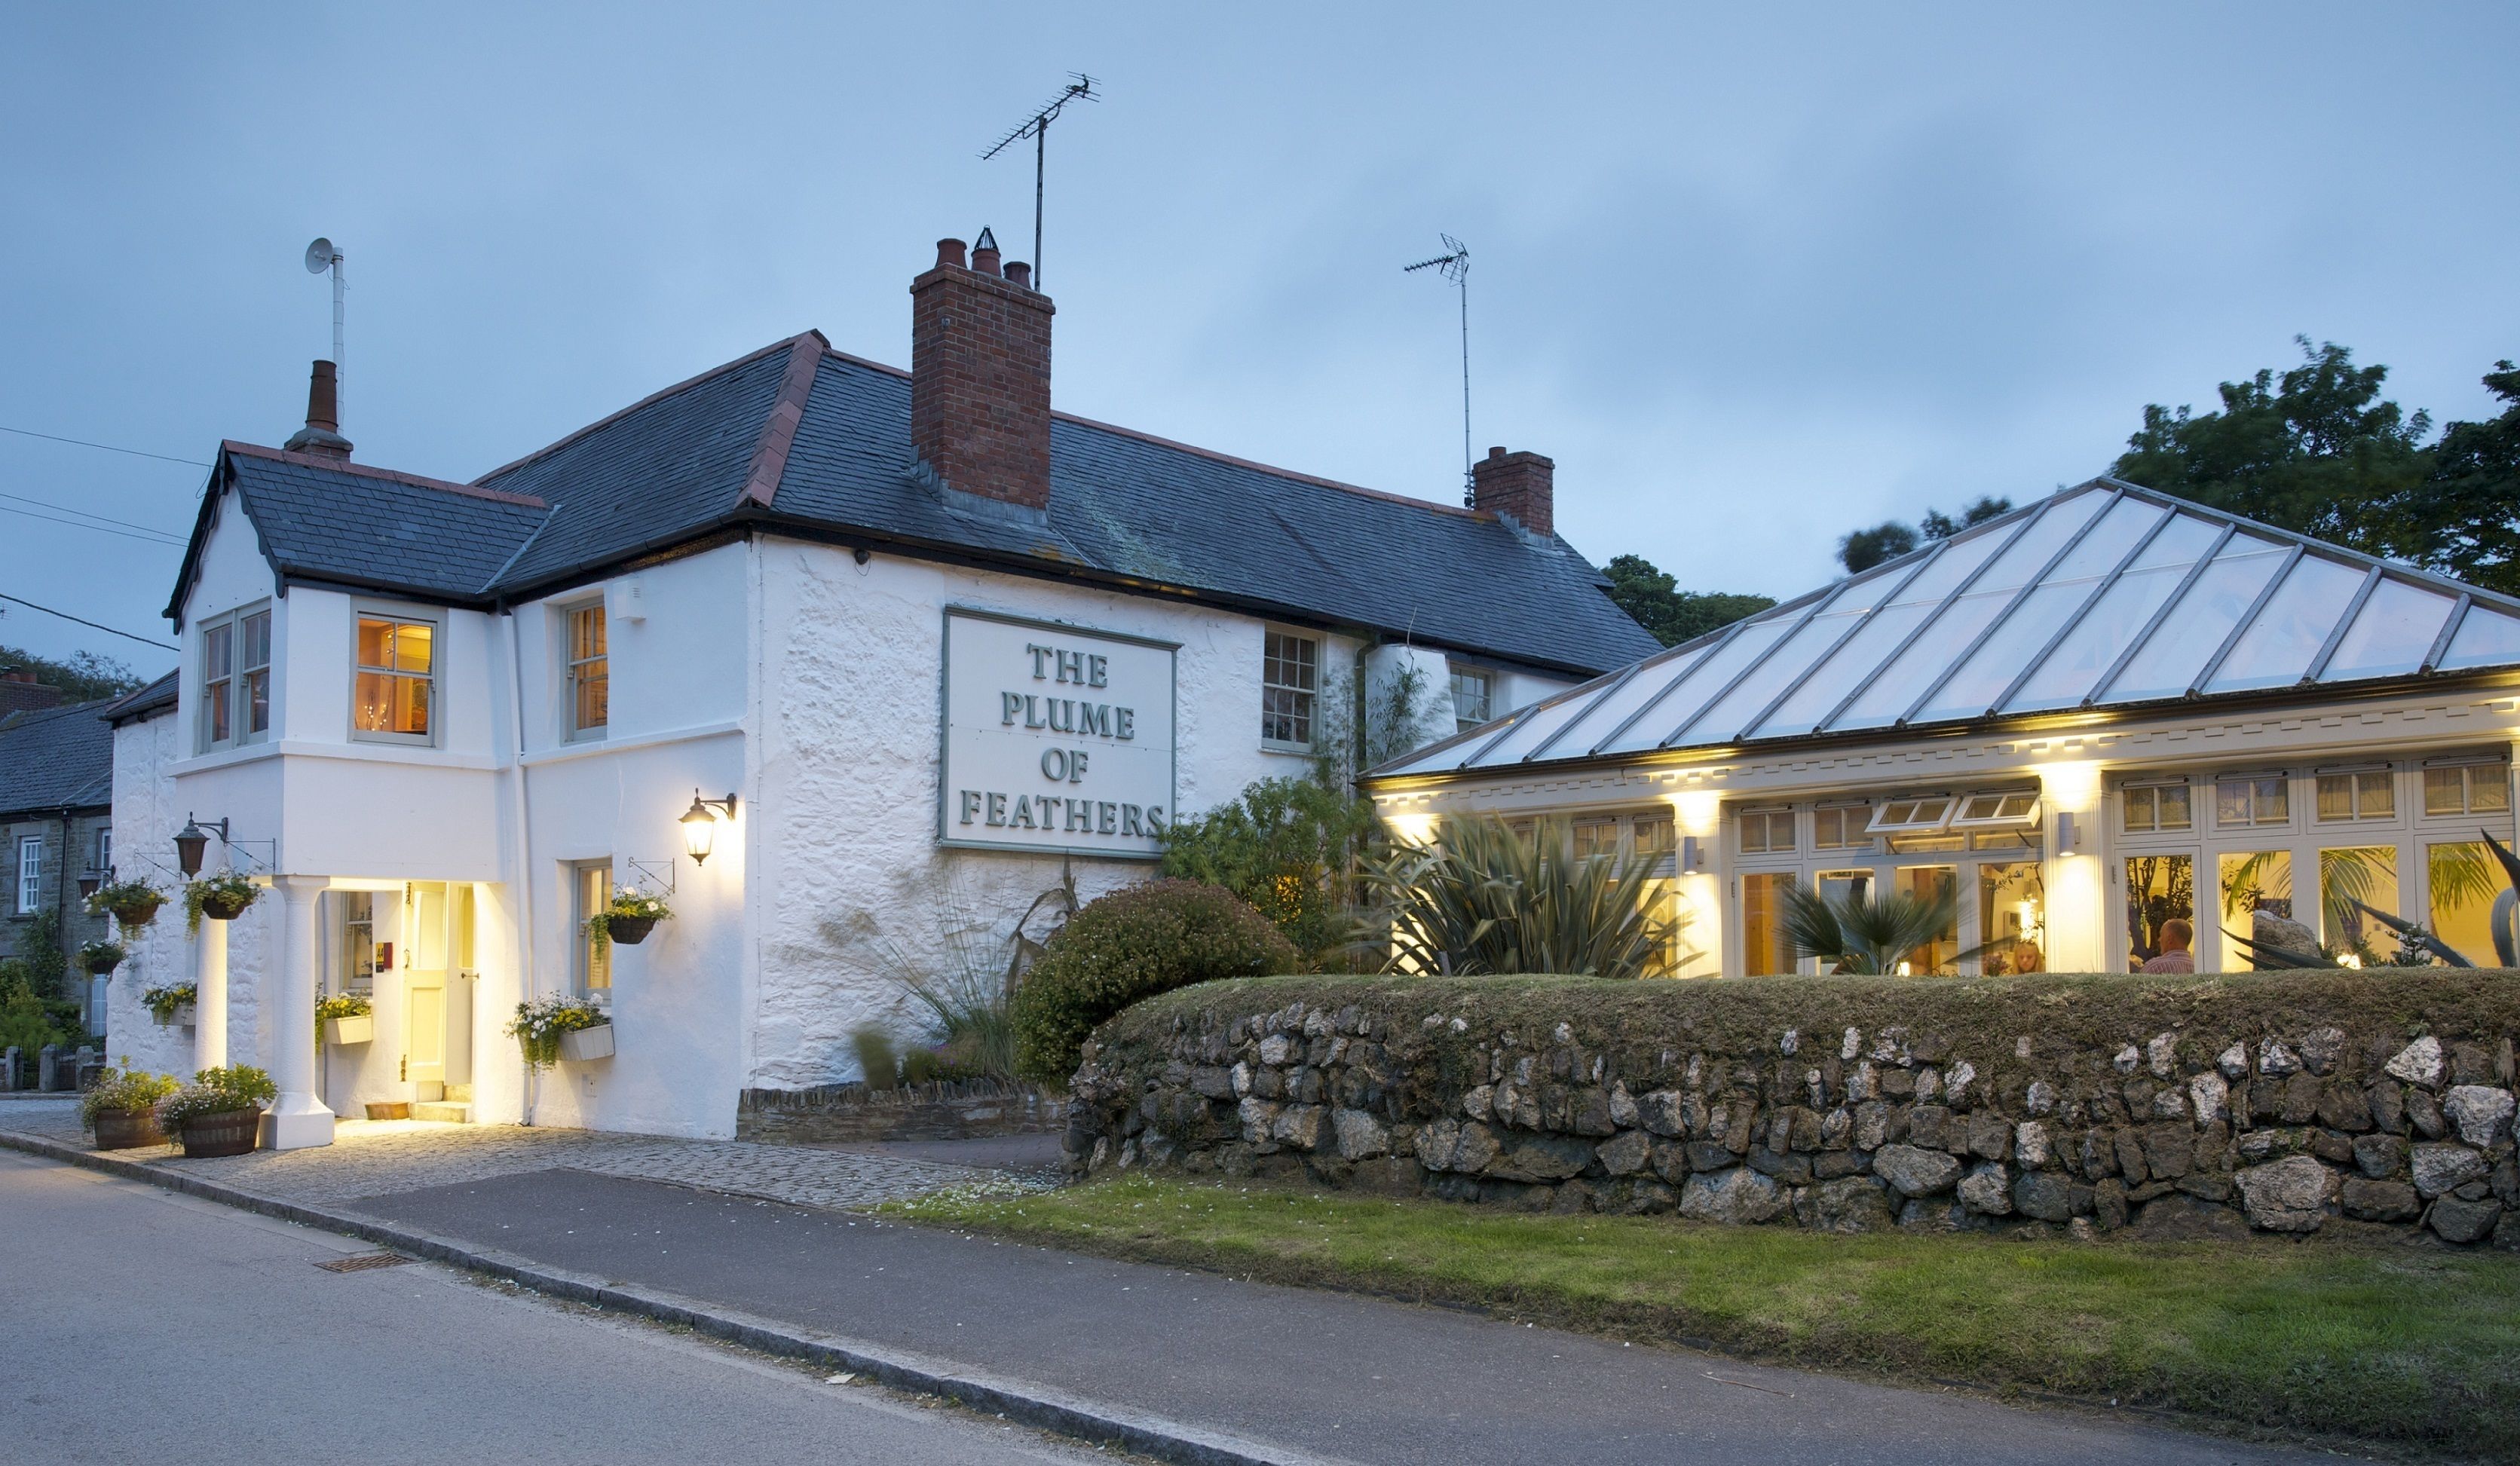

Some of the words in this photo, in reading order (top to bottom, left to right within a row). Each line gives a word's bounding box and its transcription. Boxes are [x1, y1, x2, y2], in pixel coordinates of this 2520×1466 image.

[1027, 643, 1108, 687] THE
[1002, 691, 1134, 739] PLUME
[1042, 748, 1089, 783] OF
[960, 790, 1163, 837] FEATHERS
